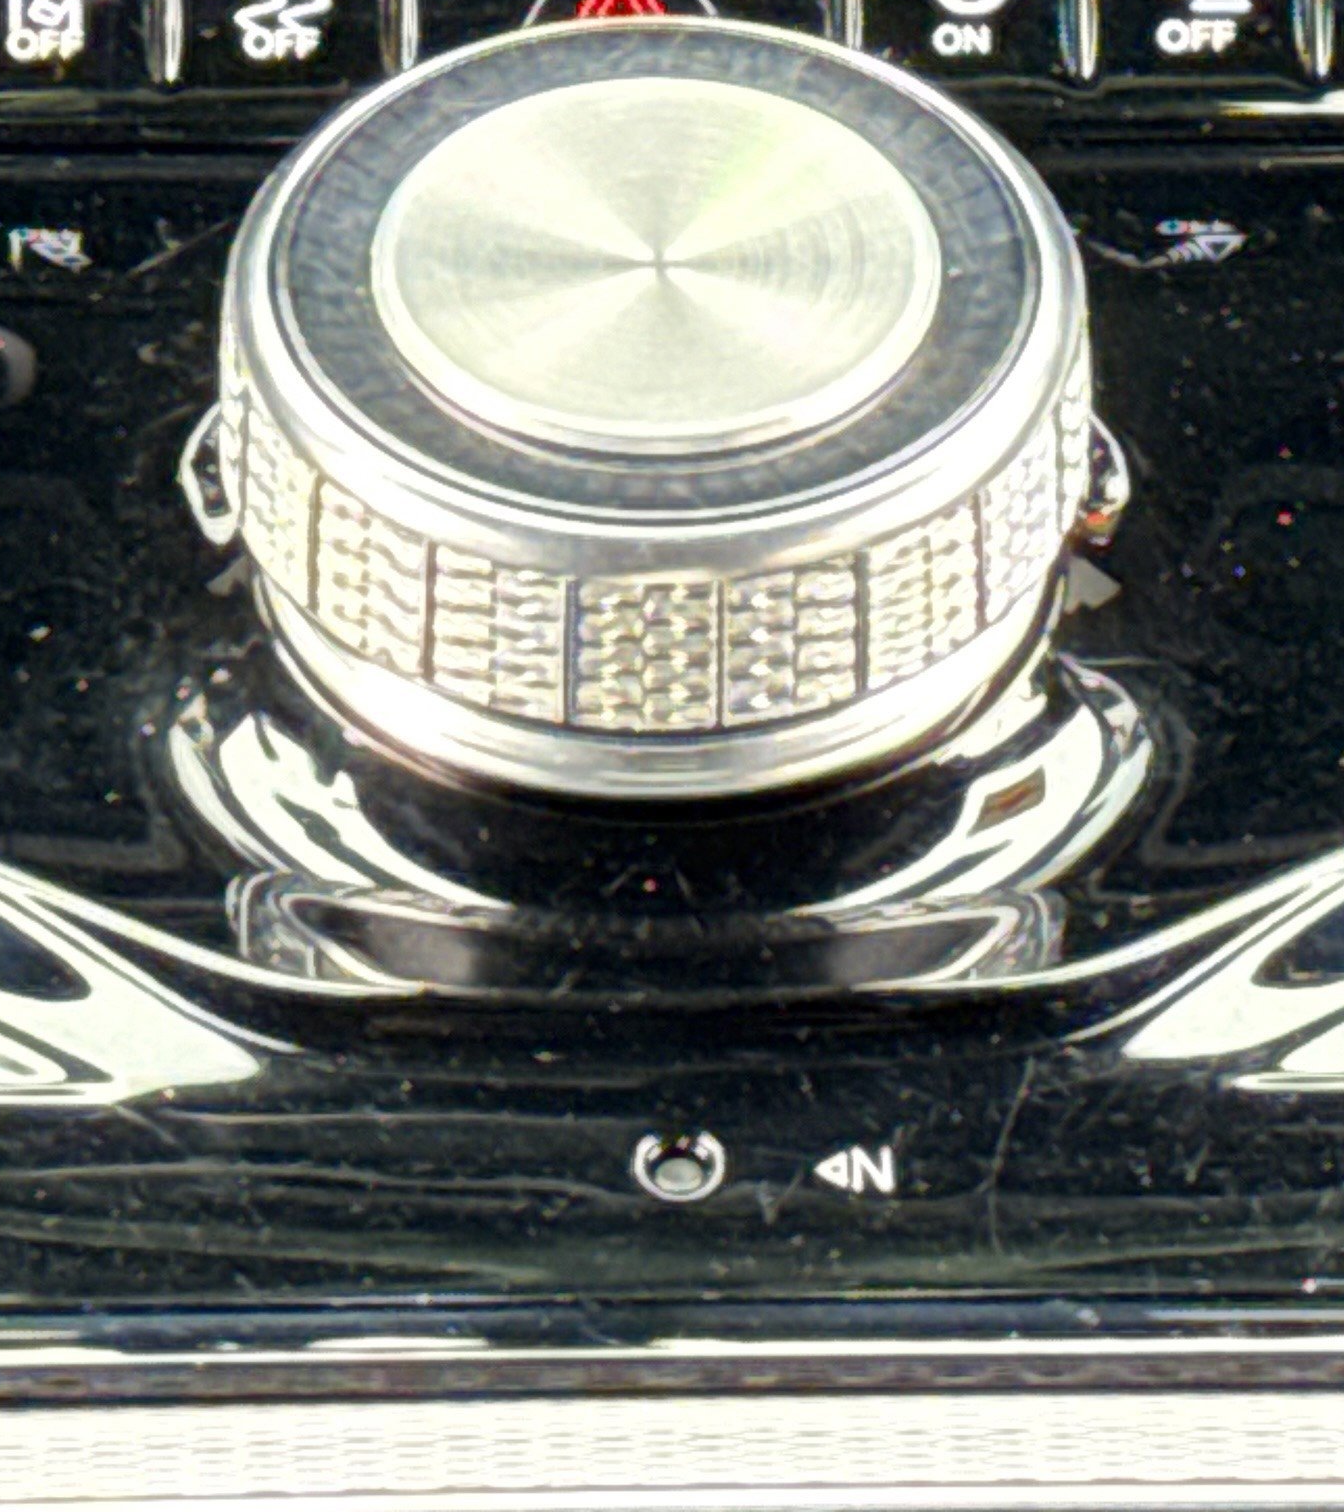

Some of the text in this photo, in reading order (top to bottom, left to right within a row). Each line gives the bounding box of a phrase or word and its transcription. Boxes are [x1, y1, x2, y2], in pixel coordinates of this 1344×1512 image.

[6, 29, 84, 61] OFF
[243, 27, 321, 59] OFF
[932, 23, 992, 55] ON
[1157, 19, 1237, 54] OFF
[850, 1145, 894, 1193] N
